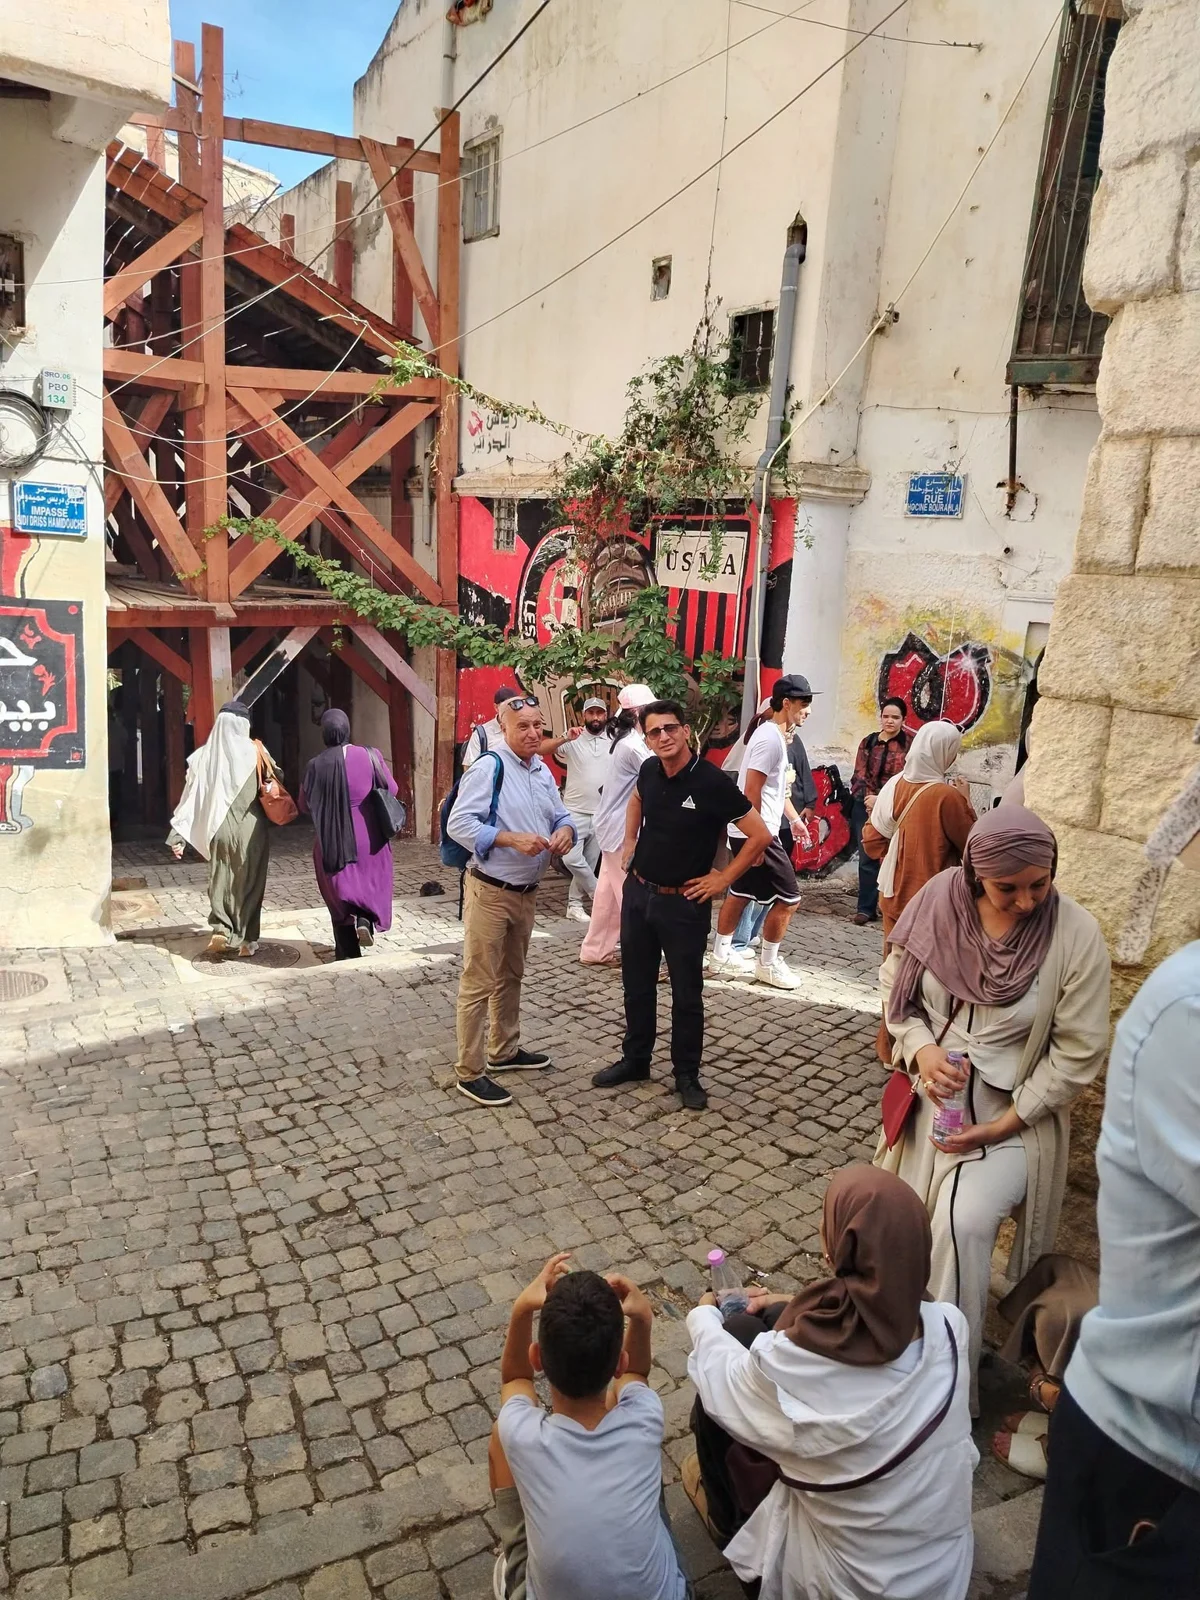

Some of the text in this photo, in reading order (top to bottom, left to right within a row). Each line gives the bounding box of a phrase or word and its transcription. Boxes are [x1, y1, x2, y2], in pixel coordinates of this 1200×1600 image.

[48, 382, 69, 392] PBO
[47, 394, 66, 404] 134
[923, 494, 945, 504] RUE
[30, 505, 69, 518] IMPASSE
[29, 515, 48, 528] DRISS
[47, 516, 86, 530] HAMIDOUCHE
[665, 548, 737, 576] USMA
